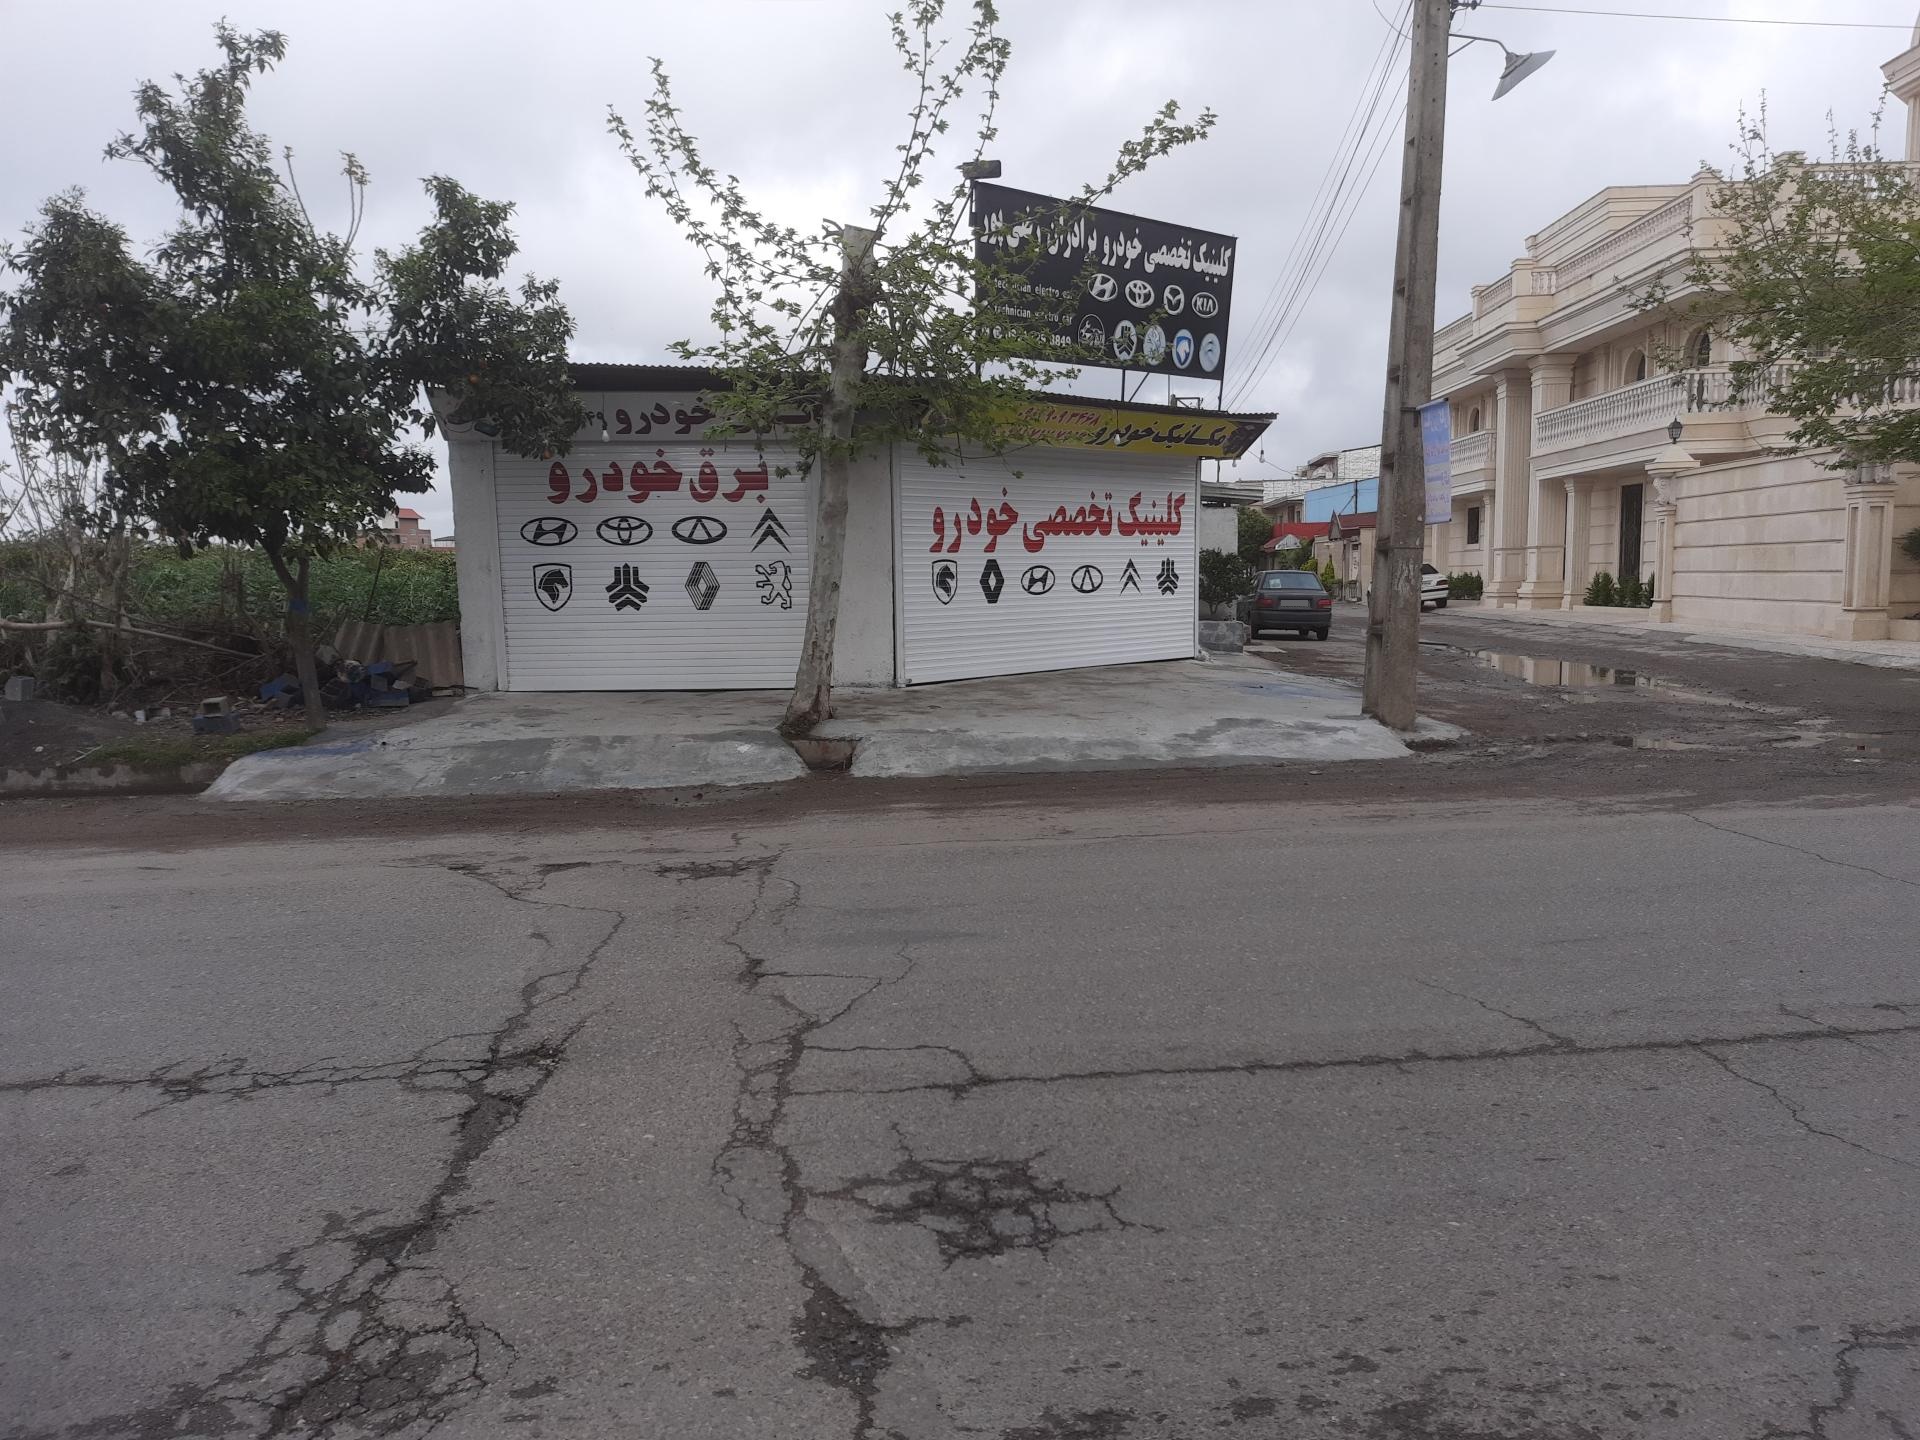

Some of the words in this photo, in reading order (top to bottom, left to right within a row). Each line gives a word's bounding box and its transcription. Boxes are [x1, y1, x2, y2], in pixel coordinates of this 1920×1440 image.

[1102, 227, 1142, 269] خودرو
[1144, 237, 1191, 273] تخصصی
[1193, 243, 1231, 283] کلینیک
[615, 396, 717, 434] خودرو
[1084, 421, 1157, 447] خودرو
[547, 448, 683, 504] خودرو
[688, 448, 769, 503] برق
[929, 486, 1019, 553] خودرو
[1022, 490, 1112, 553] تخصصی
[1117, 491, 1186, 547] کلینیک
